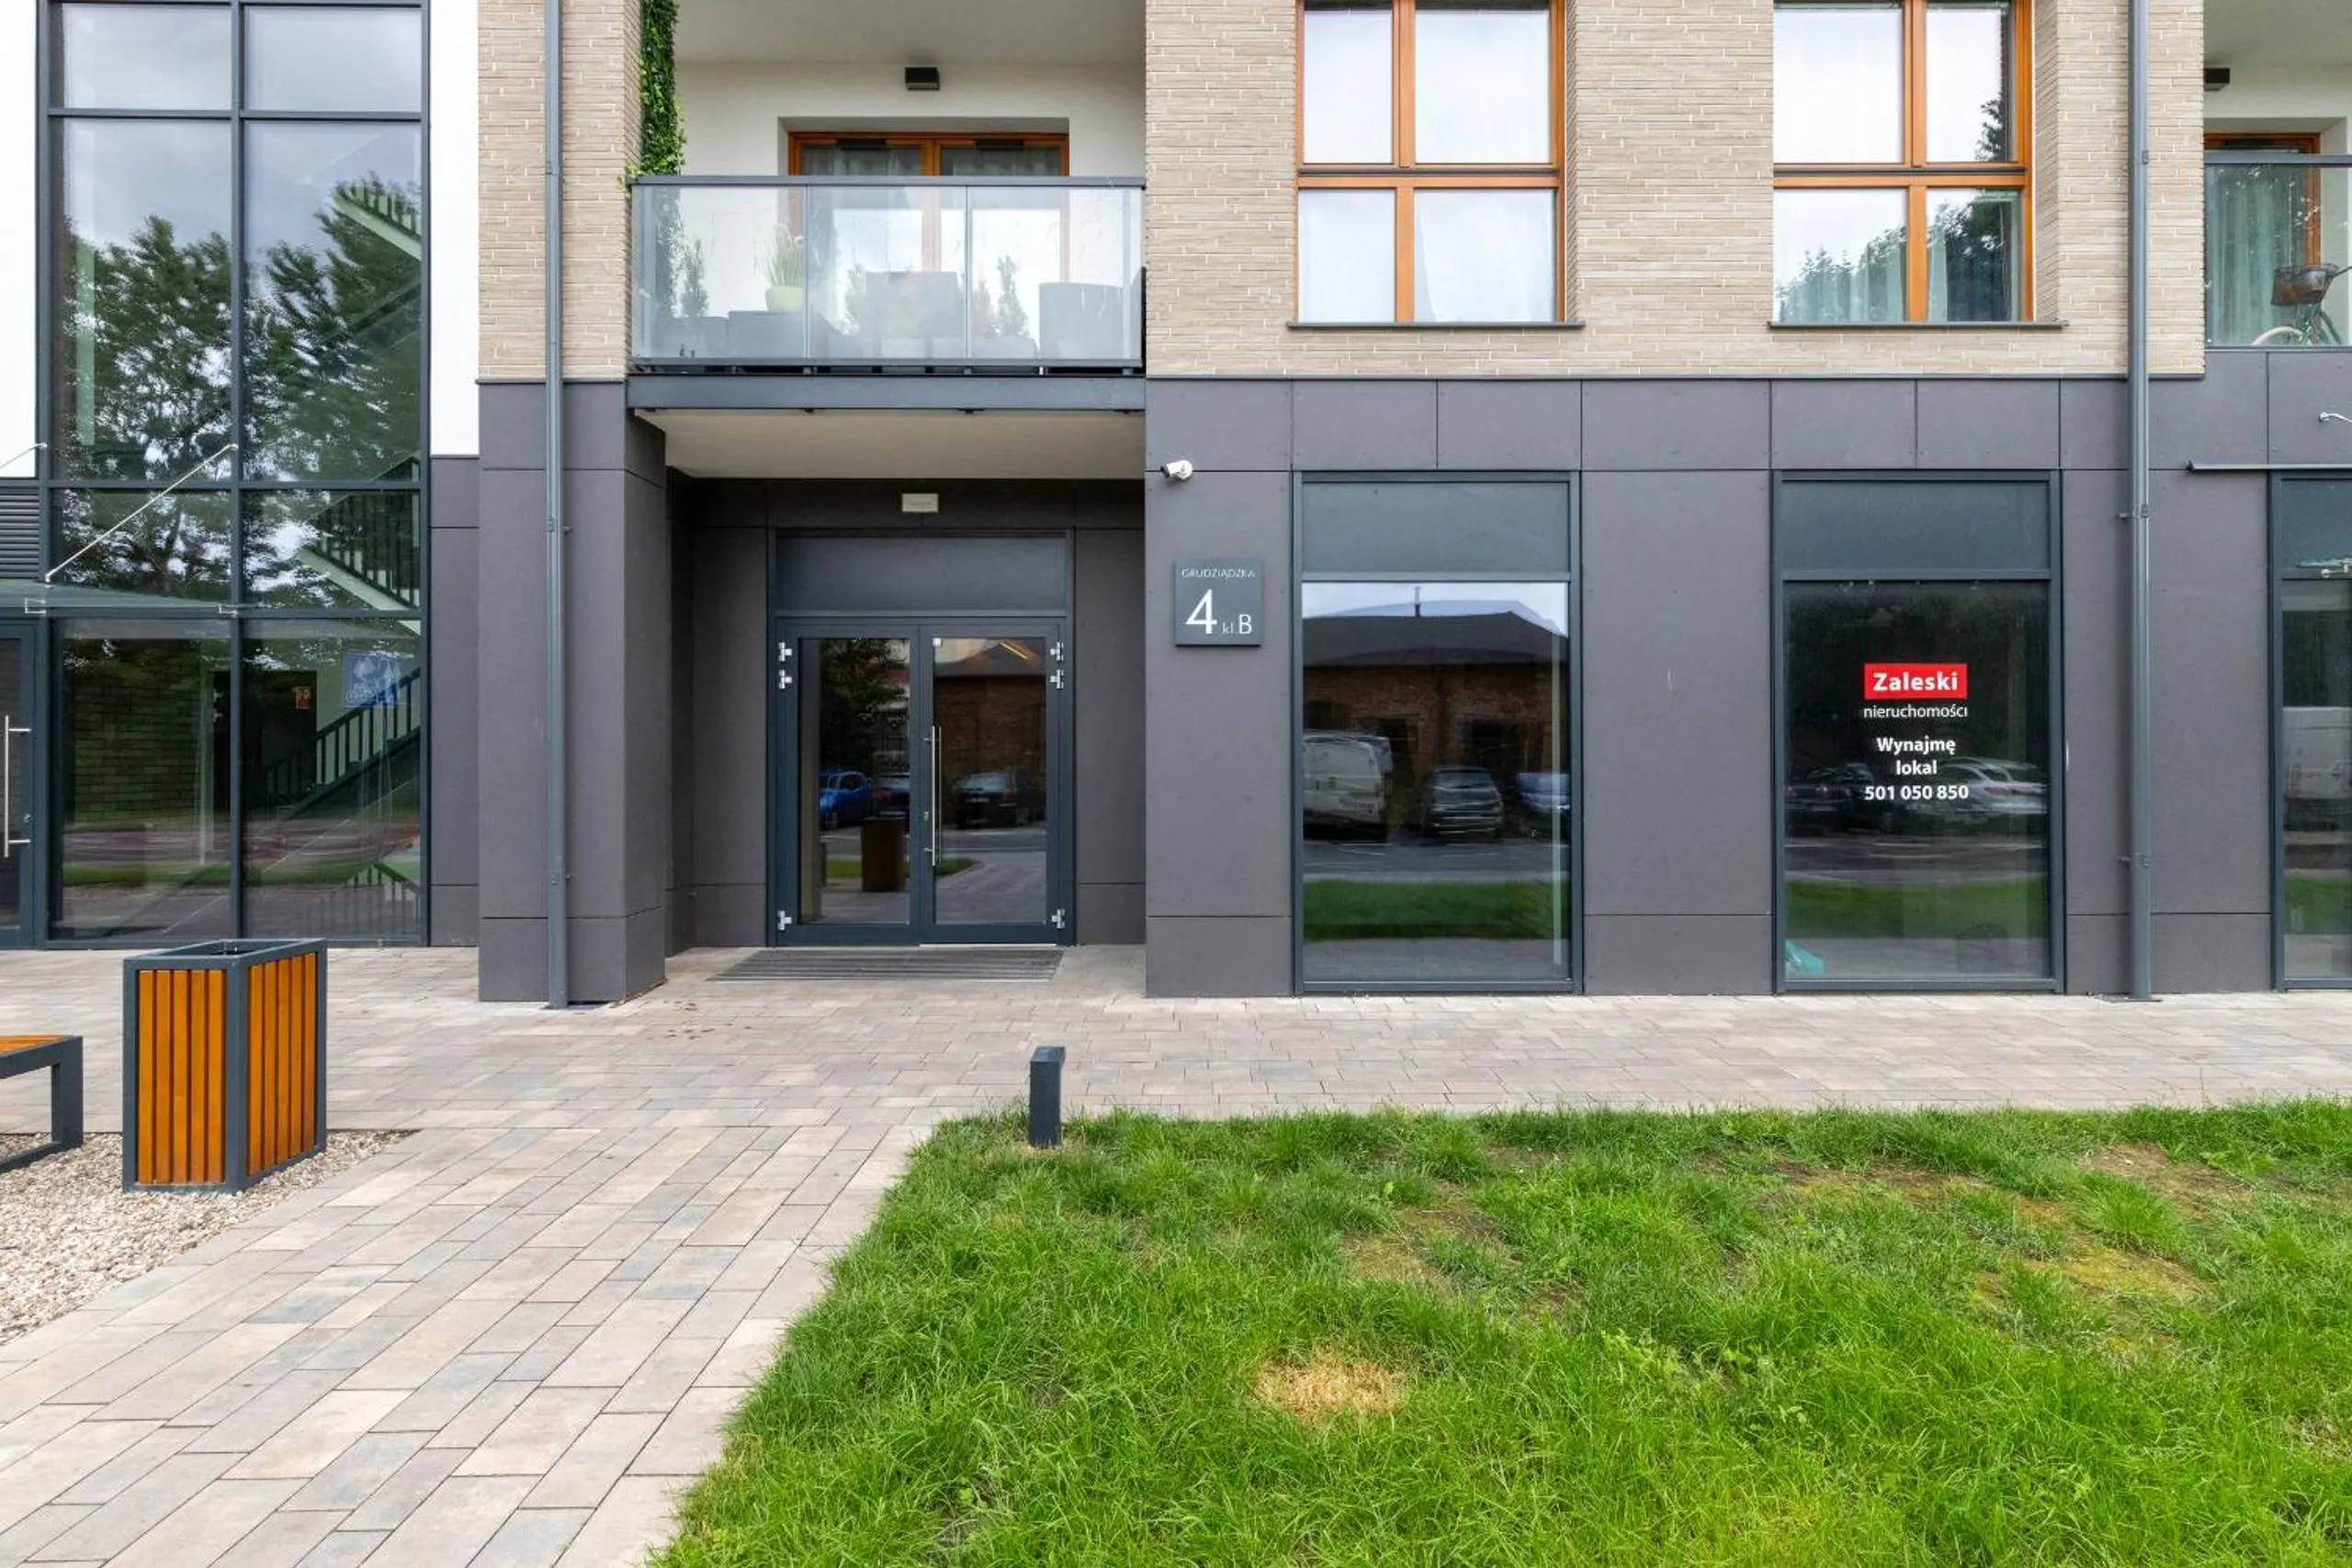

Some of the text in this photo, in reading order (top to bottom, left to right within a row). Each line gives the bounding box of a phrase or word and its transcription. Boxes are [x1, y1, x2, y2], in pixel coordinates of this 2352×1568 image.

[1185, 588, 1217, 635] 4
[1238, 614, 1253, 635] B
[1872, 671, 1959, 692] Zaleski
[1863, 704, 1968, 718] nieruchomości
[1876, 735, 1956, 756] Wynajmę
[1895, 760, 1938, 775] lokal
[1864, 784, 1970, 801] 501 050 850
